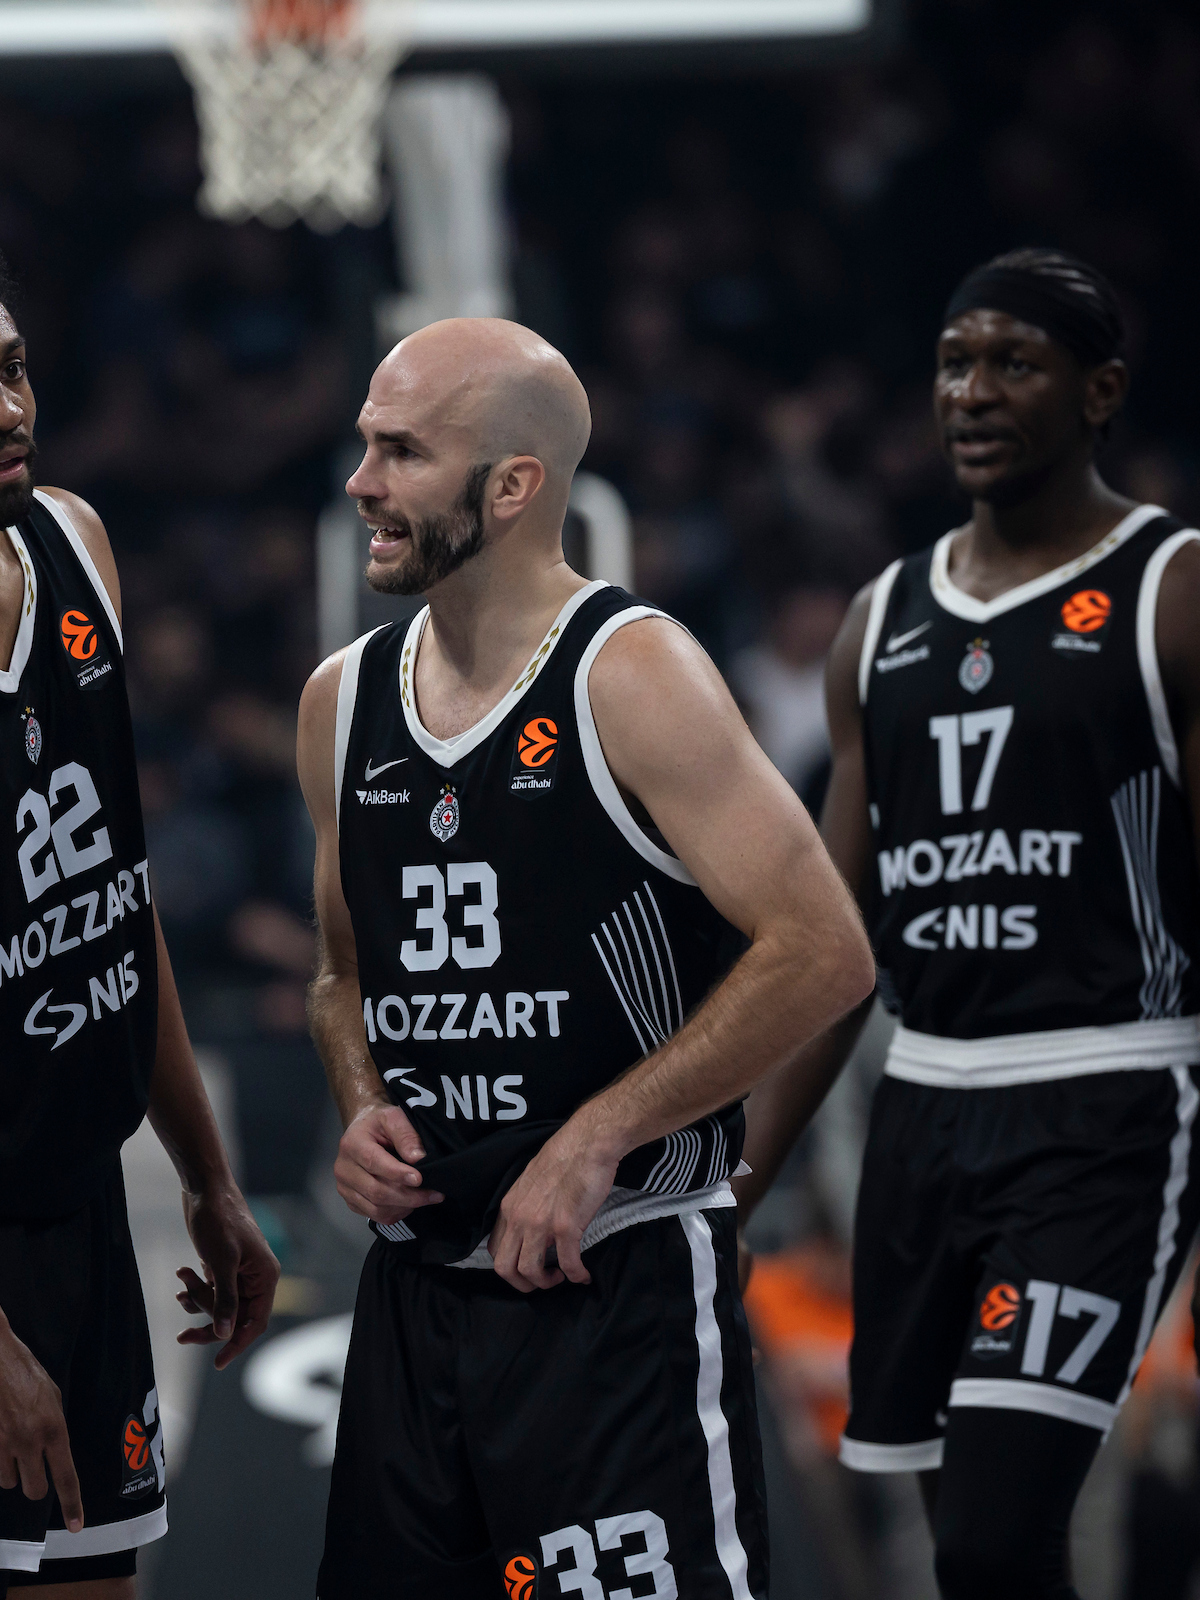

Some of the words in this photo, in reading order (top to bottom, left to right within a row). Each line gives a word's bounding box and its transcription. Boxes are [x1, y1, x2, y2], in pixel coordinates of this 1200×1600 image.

[364, 788, 411, 805] AikBank
[511, 780, 527, 789] abu
[528, 778, 551, 788] dhabi
[928, 705, 1014, 816] 17
[16, 761, 113, 904] 22
[400, 861, 502, 972] 33
[944, 904, 1039, 950] NIS
[88, 950, 140, 1021] NIS
[439, 1074, 528, 1121] NIS
[1020, 1279, 1121, 1385] 17
[539, 1509, 679, 1600] 33
